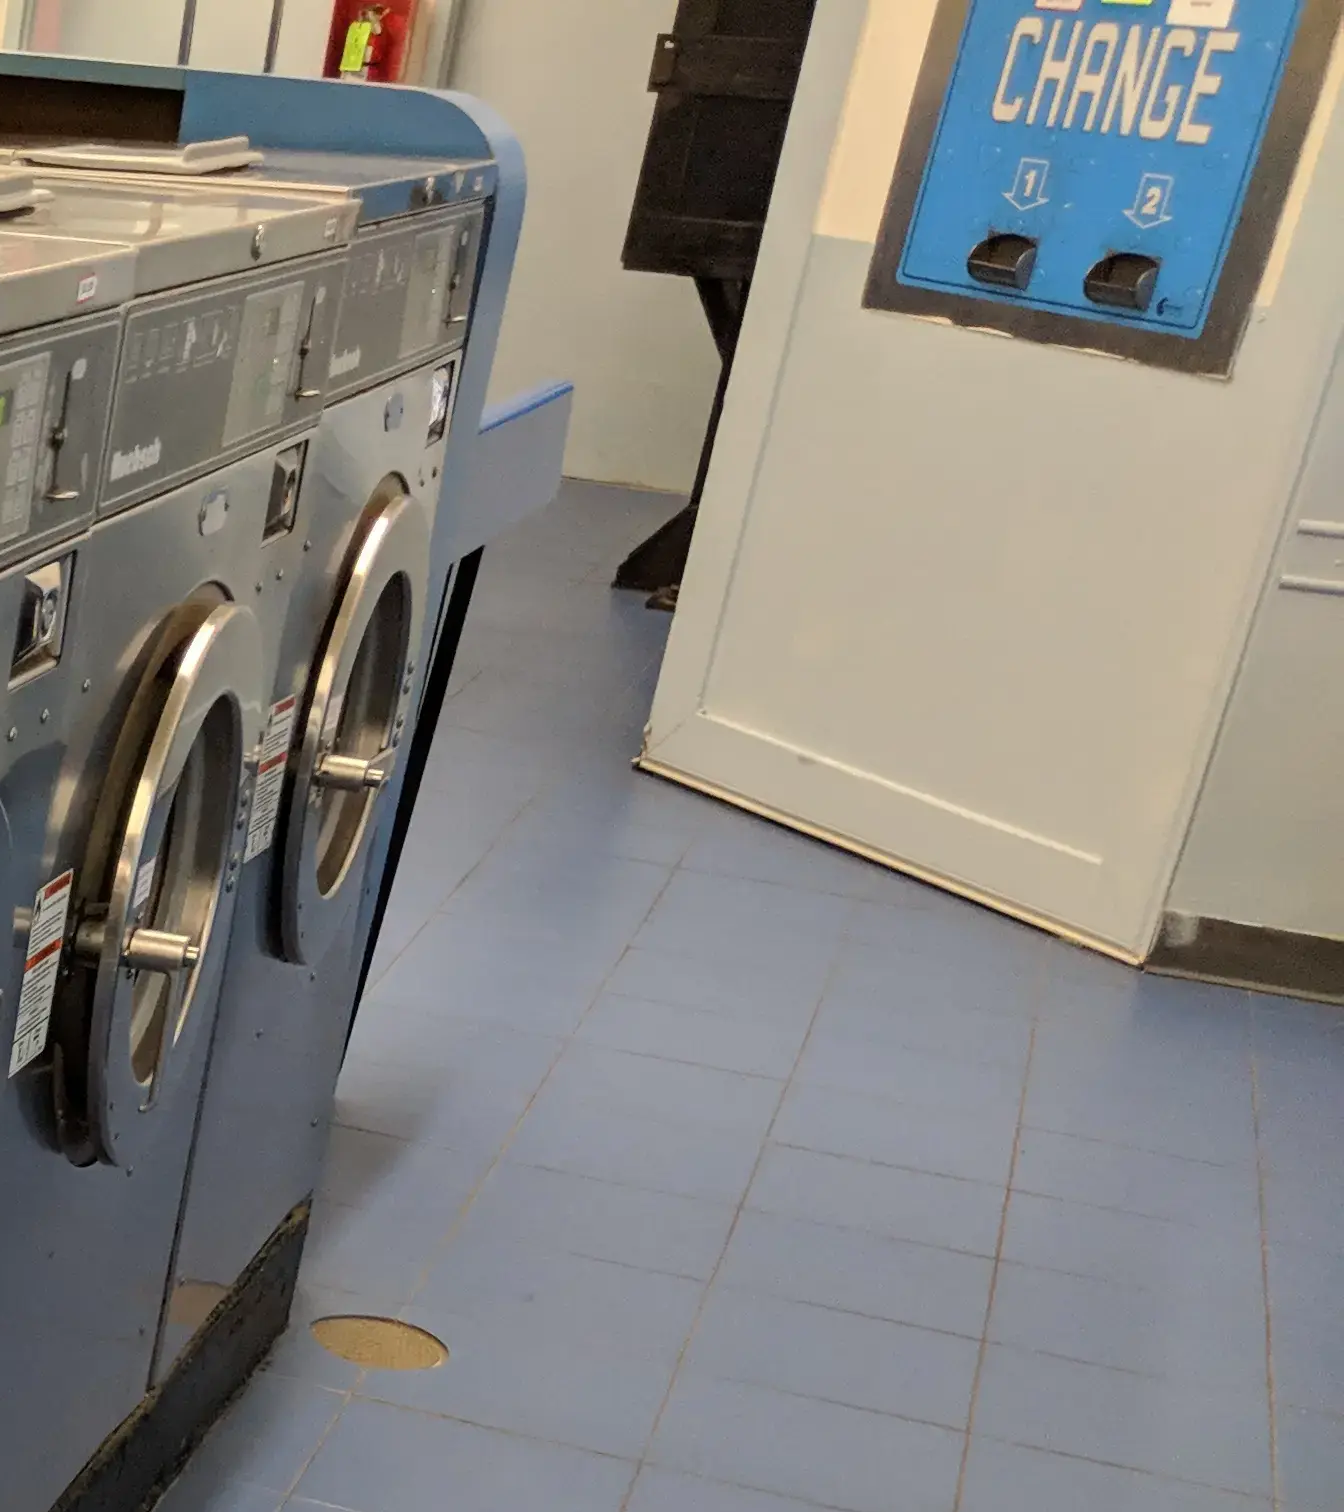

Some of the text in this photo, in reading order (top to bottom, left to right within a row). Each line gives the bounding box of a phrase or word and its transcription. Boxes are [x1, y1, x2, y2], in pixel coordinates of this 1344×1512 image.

[991, 17, 1239, 144] CHANGE
[1022, 169, 1037, 197] 1
[1141, 186, 1161, 214] 2
